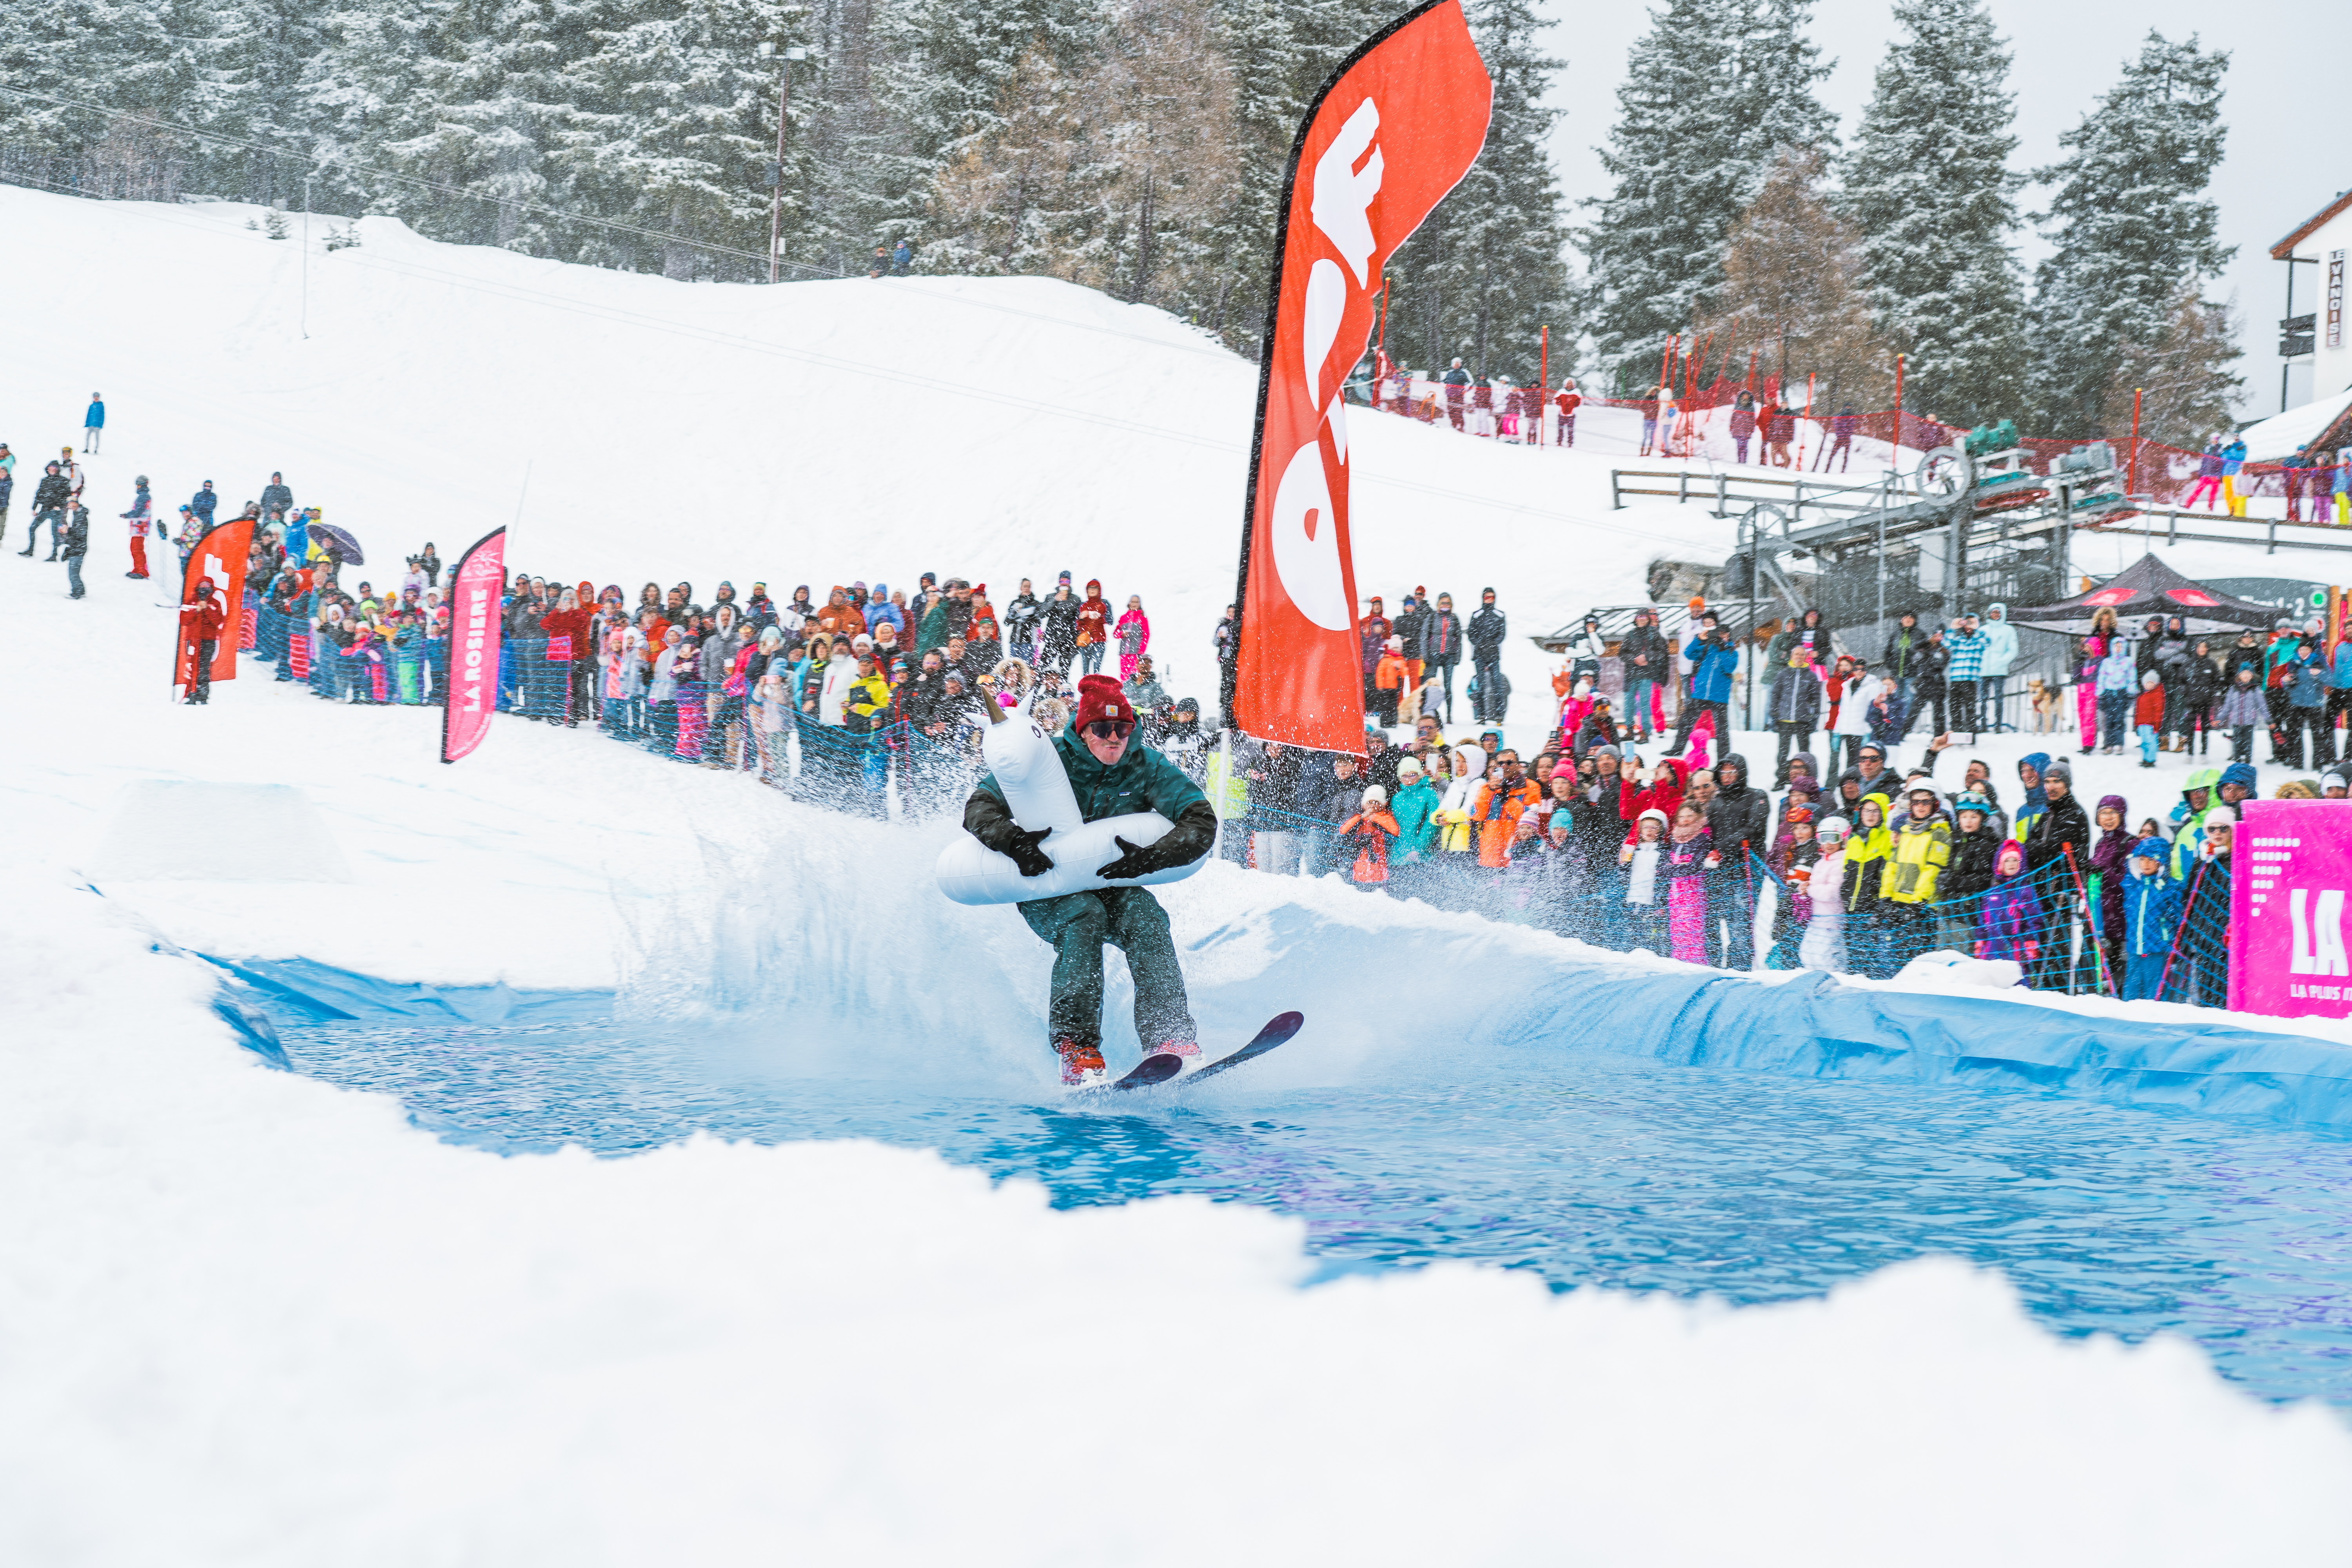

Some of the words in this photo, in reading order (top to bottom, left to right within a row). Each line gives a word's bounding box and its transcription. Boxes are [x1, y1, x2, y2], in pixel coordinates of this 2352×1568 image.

[2327, 263, 2343, 347] VANOISE
[2294, 597, 2305, 617] 2
[465, 589, 488, 681] ROSIERE
[463, 686, 481, 712] LA
[2290, 888, 2349, 976] LA
[2290, 984, 2308, 997] LA
[2308, 985, 2341, 1000] PLUS
